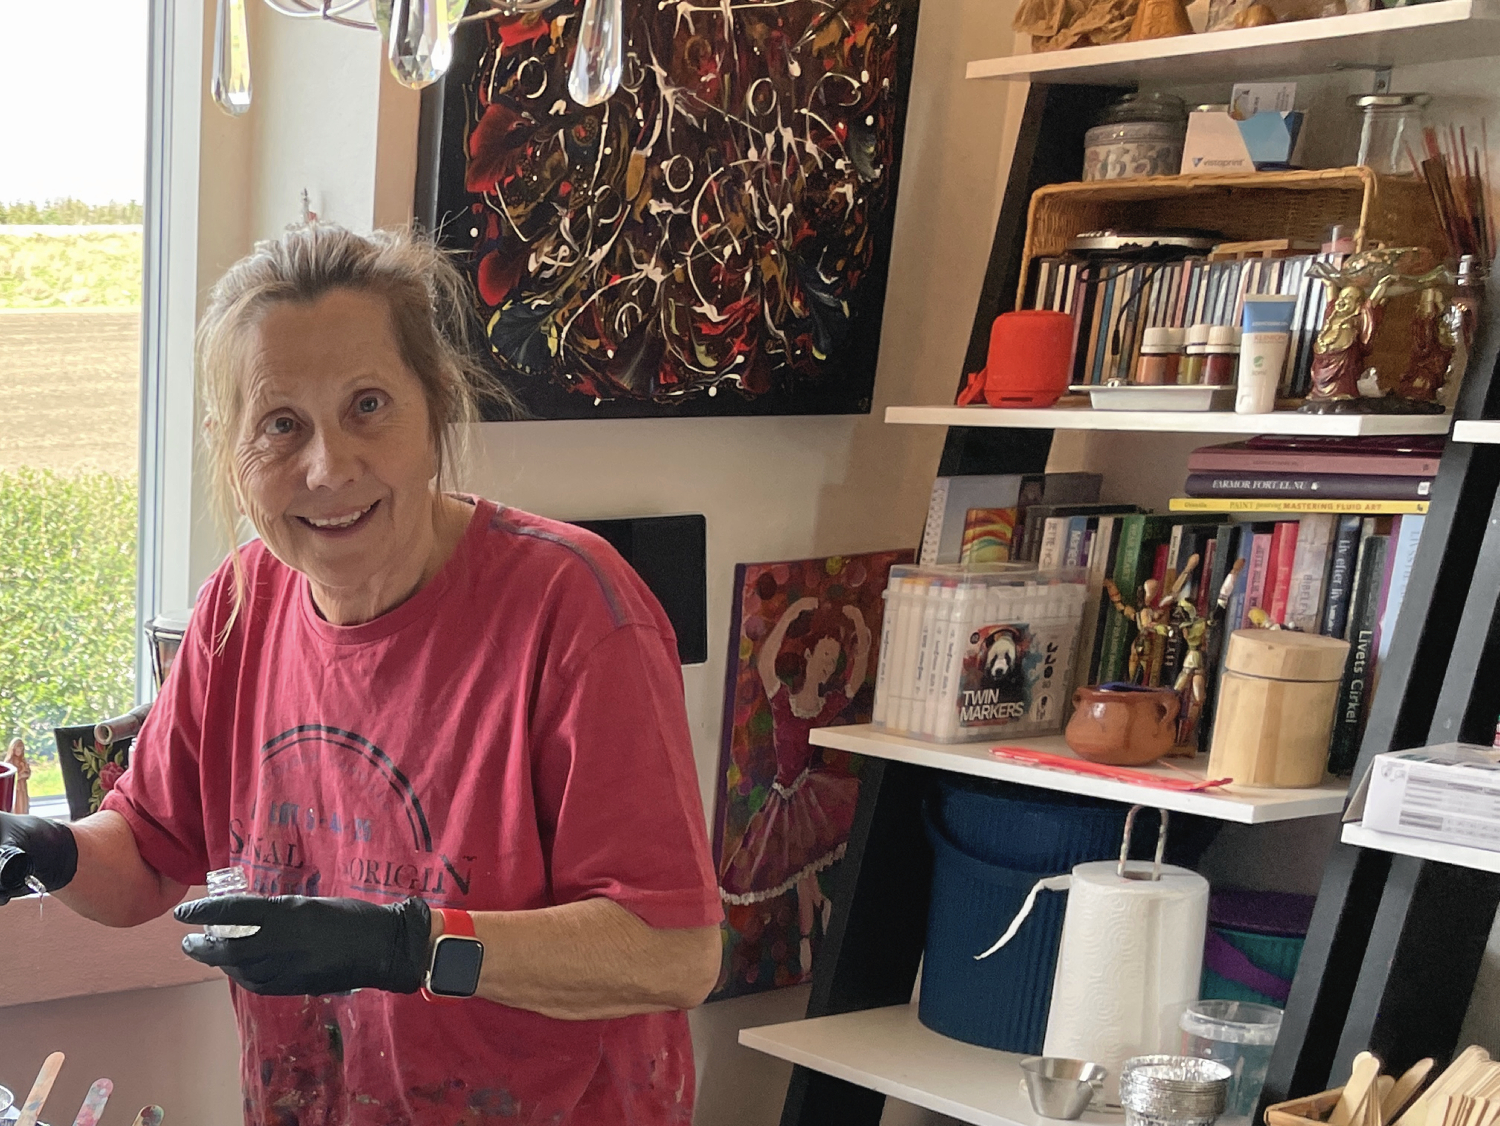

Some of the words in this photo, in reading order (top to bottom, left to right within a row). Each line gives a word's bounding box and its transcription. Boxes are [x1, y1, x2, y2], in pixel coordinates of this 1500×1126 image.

[1203, 158, 1243, 169] vistaprint
[1283, 502, 1334, 510] MASTERING
[1364, 503, 1382, 511] ART
[1353, 630, 1373, 674] Livets
[963, 688, 1000, 706] TWIN
[1345, 679, 1364, 724] Cirkel
[960, 701, 1025, 721] MARKERS
